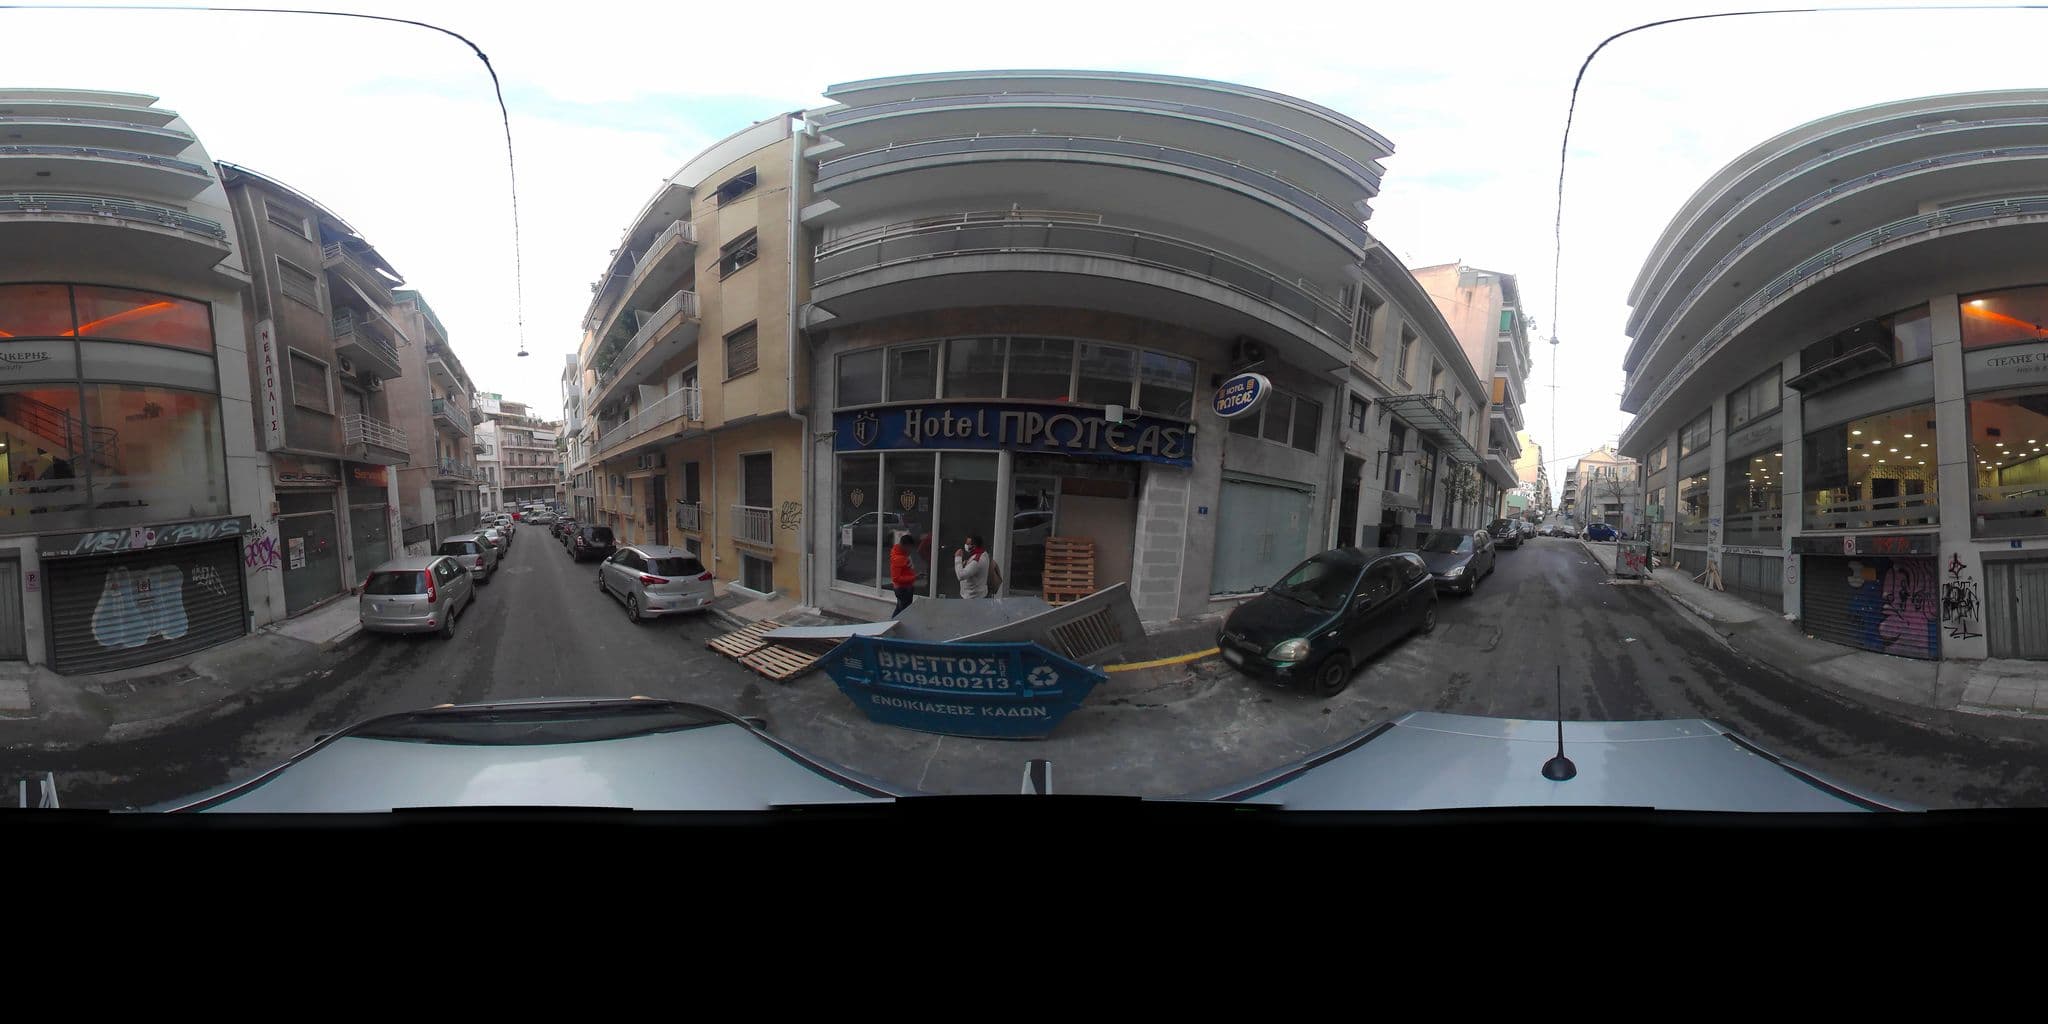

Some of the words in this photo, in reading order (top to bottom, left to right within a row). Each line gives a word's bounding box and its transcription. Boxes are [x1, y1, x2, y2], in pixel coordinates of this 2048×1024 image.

[262, 330, 277, 431] ΝΕΑΠΟΛΙΣ
[904, 409, 989, 444] Hotel
[1000, 411, 1185, 459] ΠΡΩΤΕΑΣ
[877, 651, 998, 675] ΒΡΕΤΤΟΣ
[882, 670, 1010, 689] 2109400213
[872, 695, 976, 716] ΕΝΟΙΚΙΑΣΕΙΣ
[982, 706, 1047, 717] ΚΑΔΩΝ
